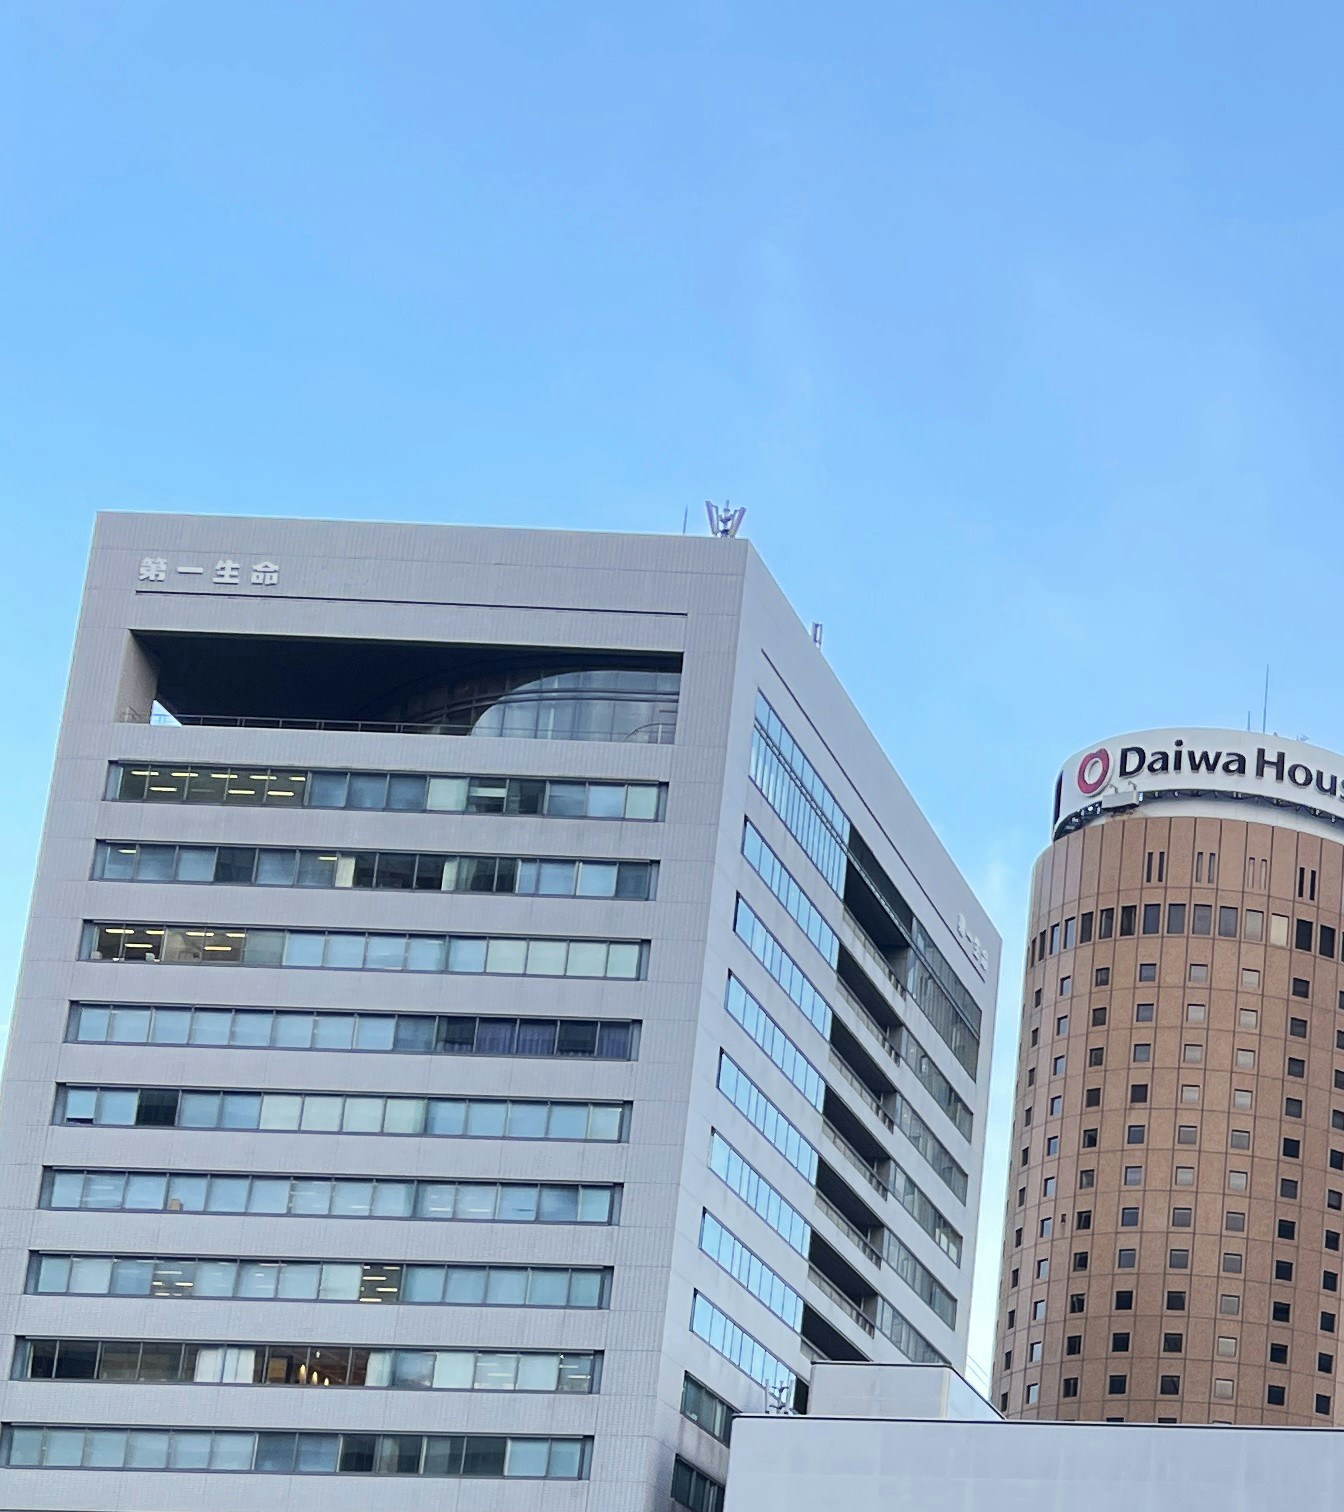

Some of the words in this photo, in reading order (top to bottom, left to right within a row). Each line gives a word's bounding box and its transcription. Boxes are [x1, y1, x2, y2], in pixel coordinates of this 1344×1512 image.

[139, 557, 279, 586] 第一生命
[1119, 739, 1246, 778] Daiwa
